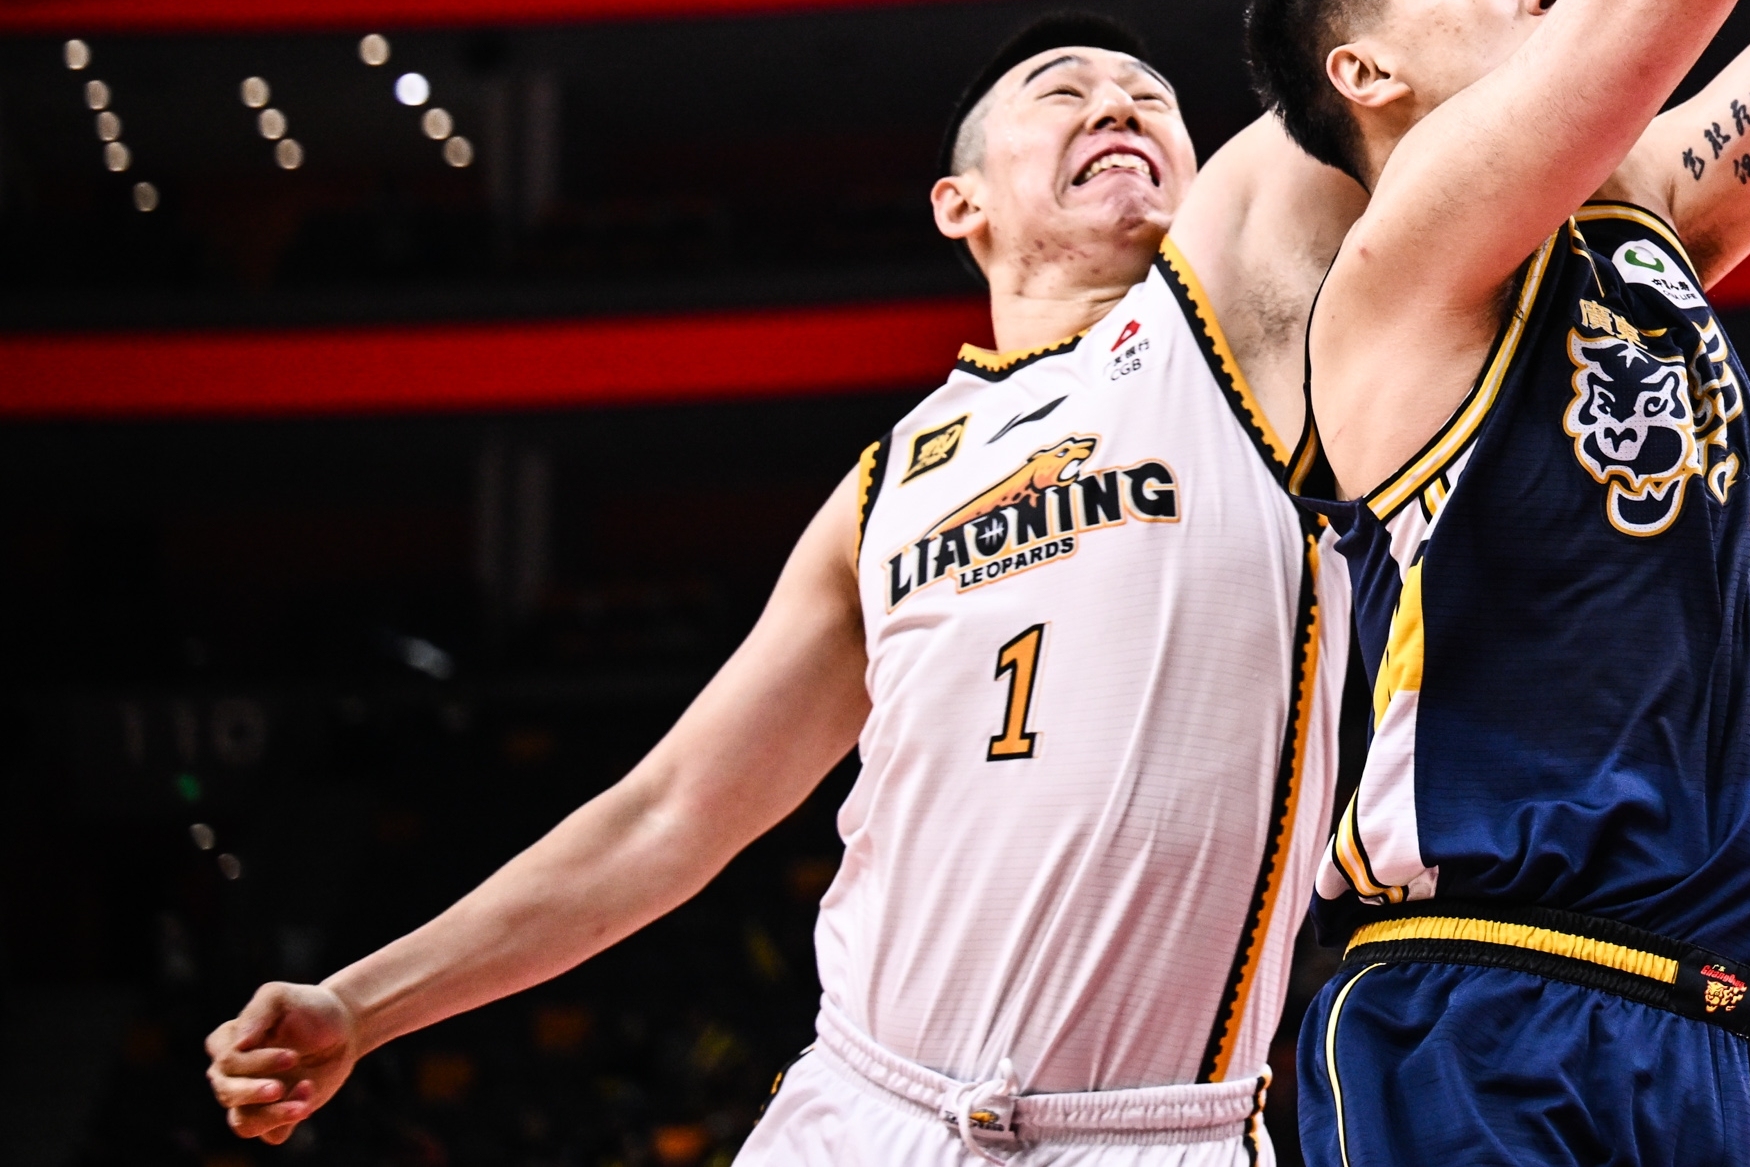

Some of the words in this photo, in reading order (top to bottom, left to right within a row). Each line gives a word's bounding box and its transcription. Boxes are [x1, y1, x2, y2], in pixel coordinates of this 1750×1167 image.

[1110, 358, 1143, 381] CGB
[886, 460, 1180, 613] LIAONING
[958, 536, 1075, 590] LEOPARDS
[985, 622, 1048, 762] 1
